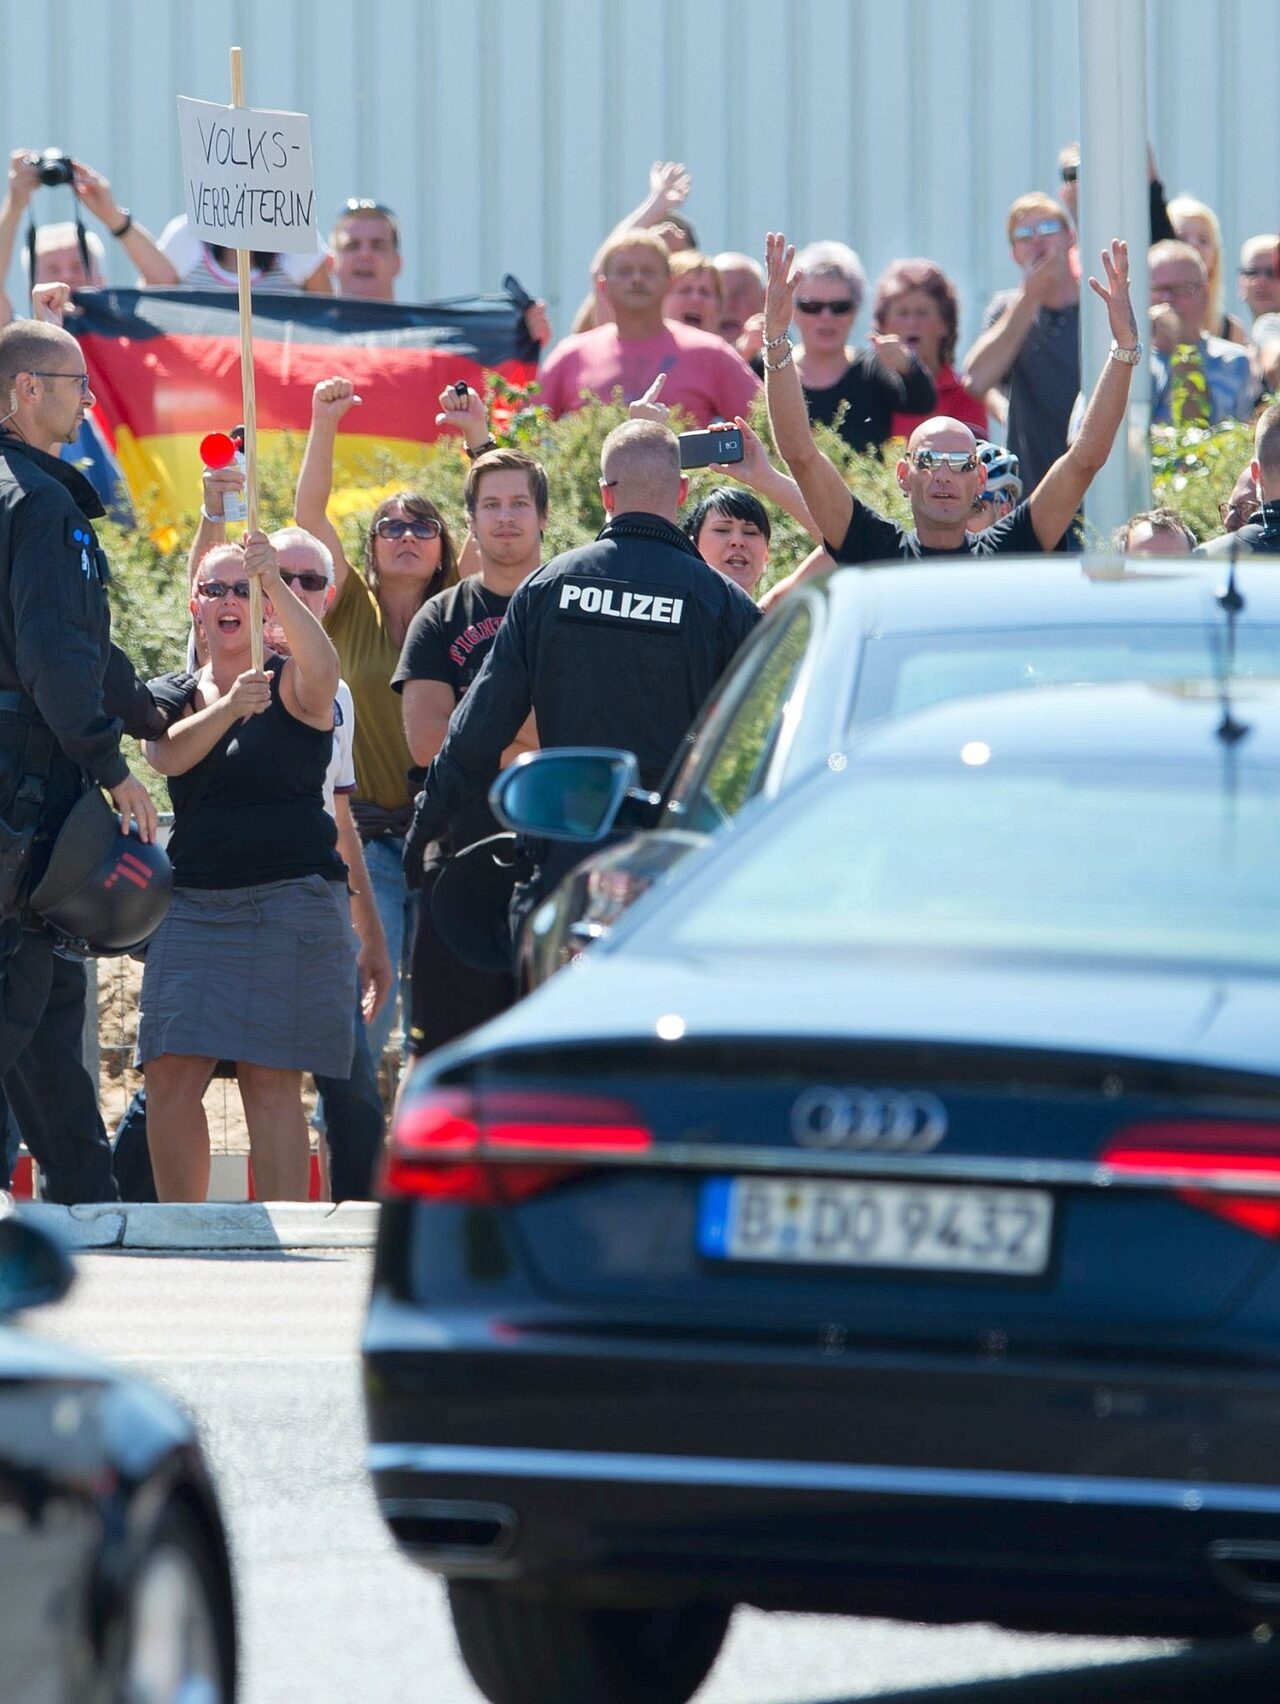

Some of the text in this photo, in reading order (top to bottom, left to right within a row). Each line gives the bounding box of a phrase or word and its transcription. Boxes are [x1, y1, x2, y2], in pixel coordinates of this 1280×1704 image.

[197, 117, 300, 173] VOLKS-
[190, 179, 313, 229] VERRÄTERIN
[559, 584, 684, 624] POLIZEI
